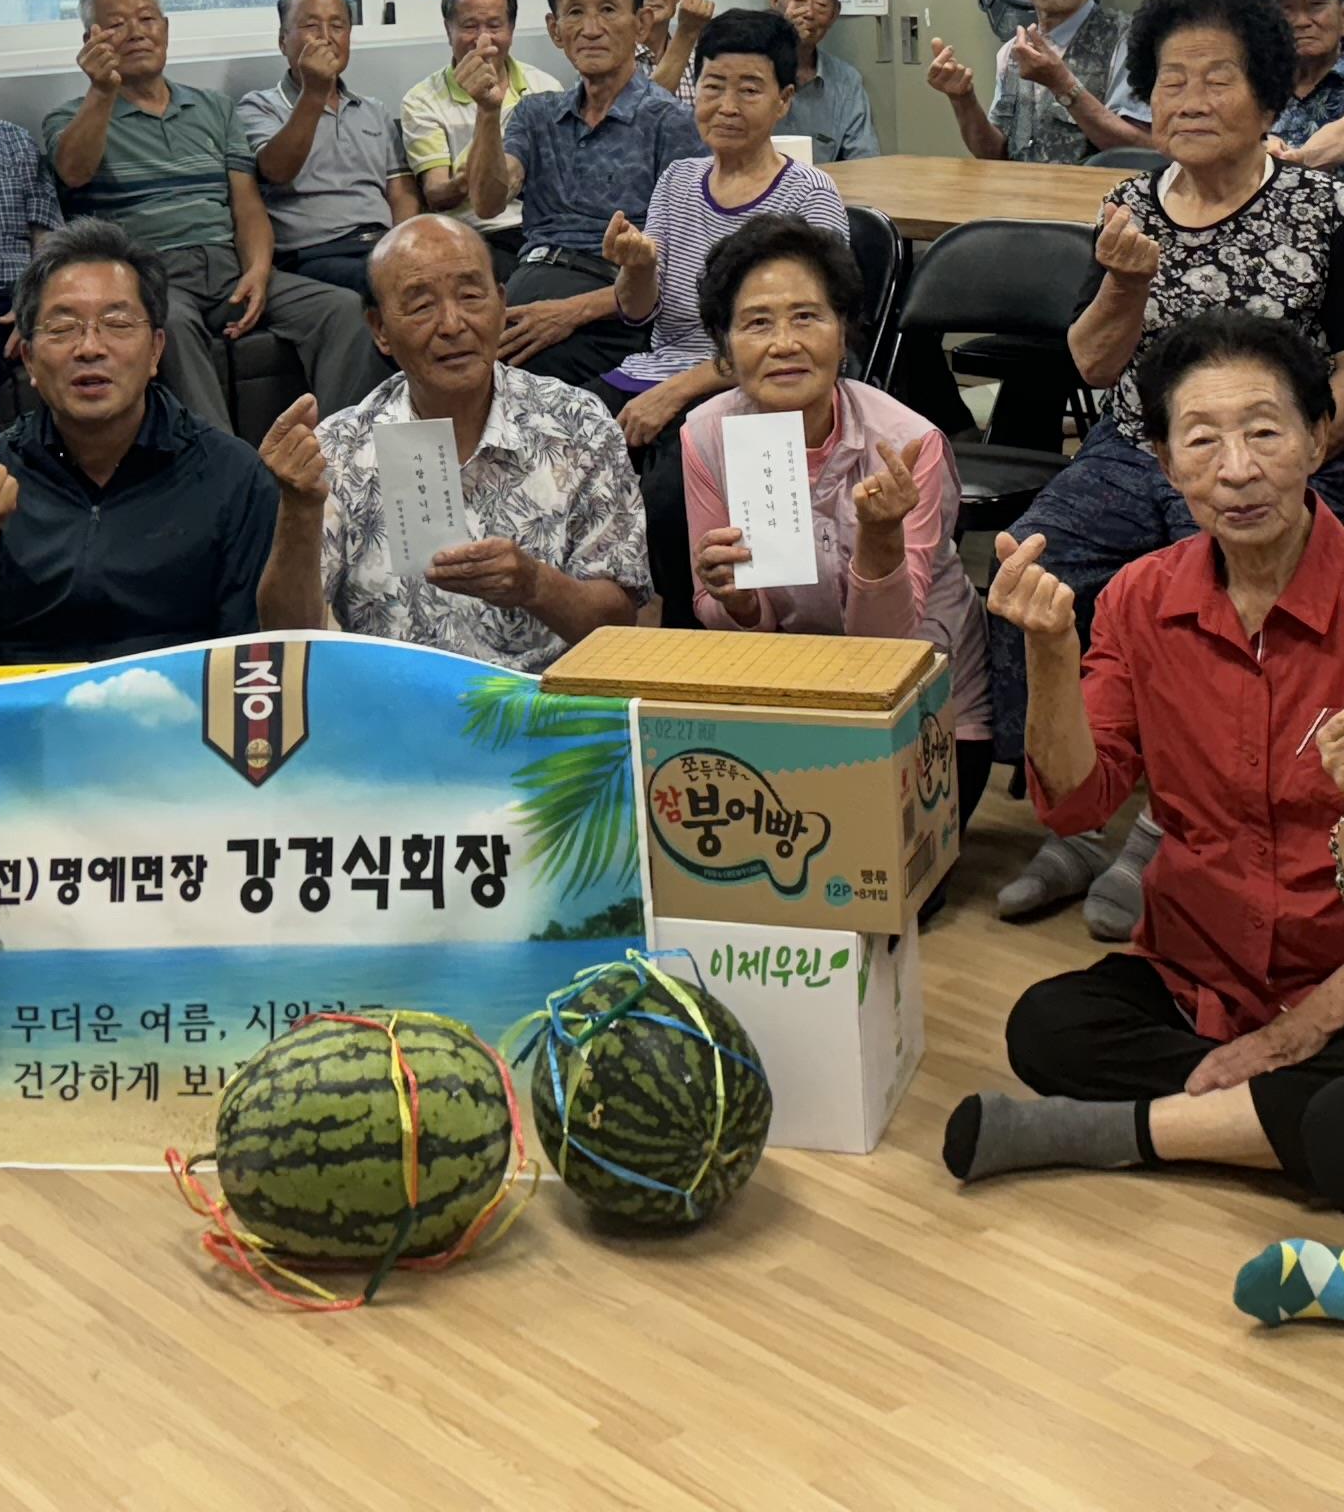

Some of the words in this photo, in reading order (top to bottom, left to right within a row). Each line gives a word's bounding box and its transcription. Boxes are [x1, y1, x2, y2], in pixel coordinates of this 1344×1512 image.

[412, 453, 431, 525] 사랑합니다
[762, 449, 777, 528] 사랑합니다
[233, 660, 281, 720] 증
[653, 786, 682, 823] 참
[681, 784, 809, 858] 붕어빵
[49, 854, 208, 906] 명예면장
[226, 833, 511, 914] 강경식회장
[826, 883, 852, 897] 12P
[709, 943, 831, 988] 이제우린
[10, 1002, 123, 1043] 무더운
[140, 1002, 227, 1043] 여름,
[13, 1061, 159, 1102] 건강하게
